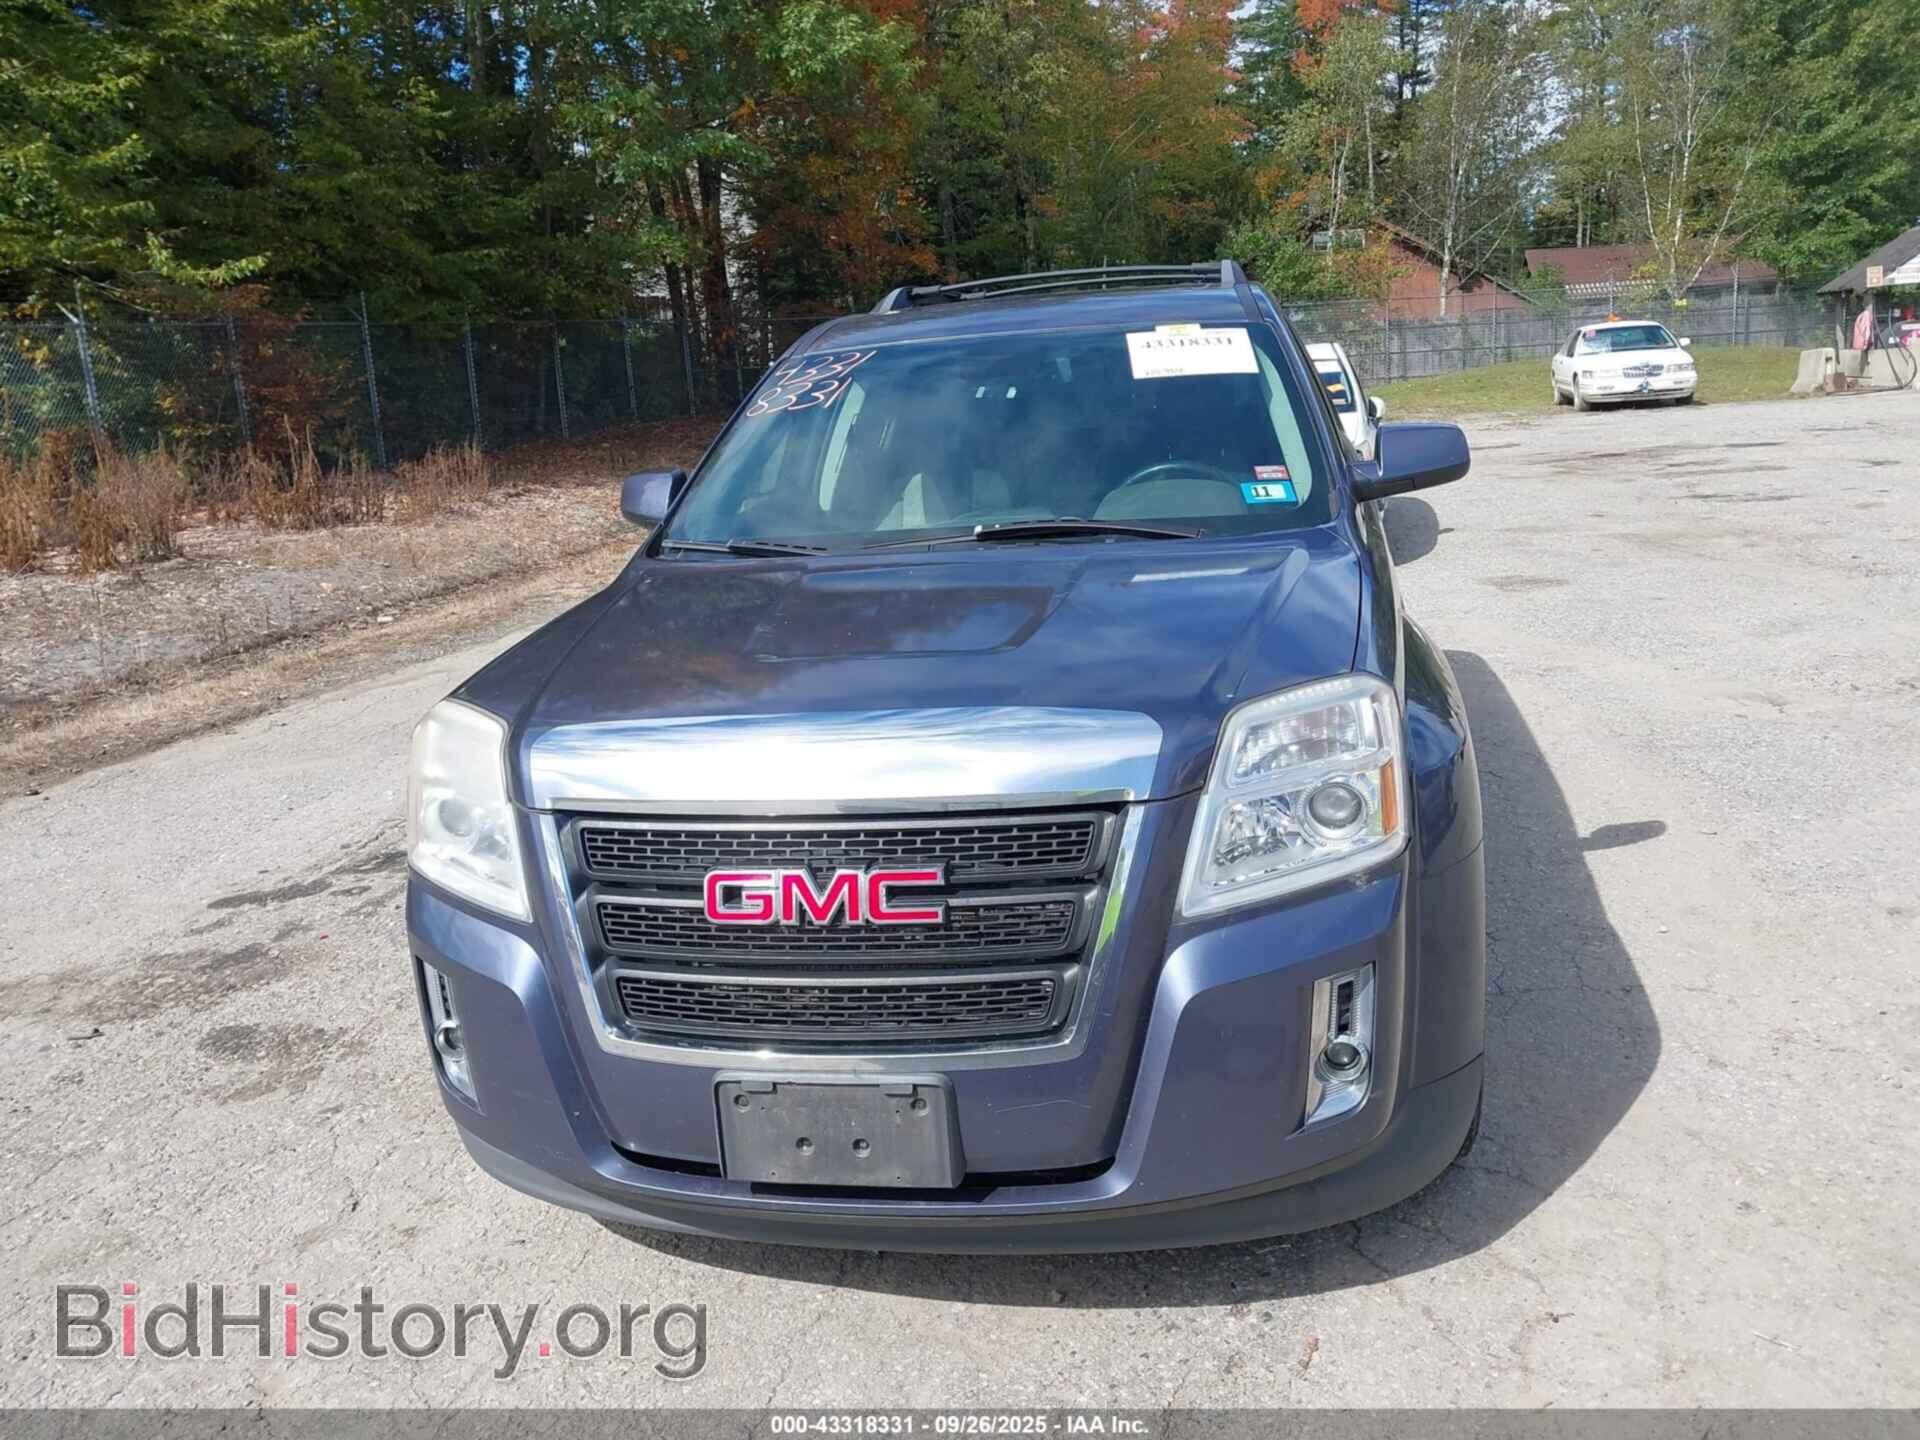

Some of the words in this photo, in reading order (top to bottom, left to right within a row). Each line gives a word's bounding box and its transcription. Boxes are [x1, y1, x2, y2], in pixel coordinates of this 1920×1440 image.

[746, 377, 852, 416] 8331
[1253, 486, 1272, 497] 11
[704, 868, 945, 925] GMC
